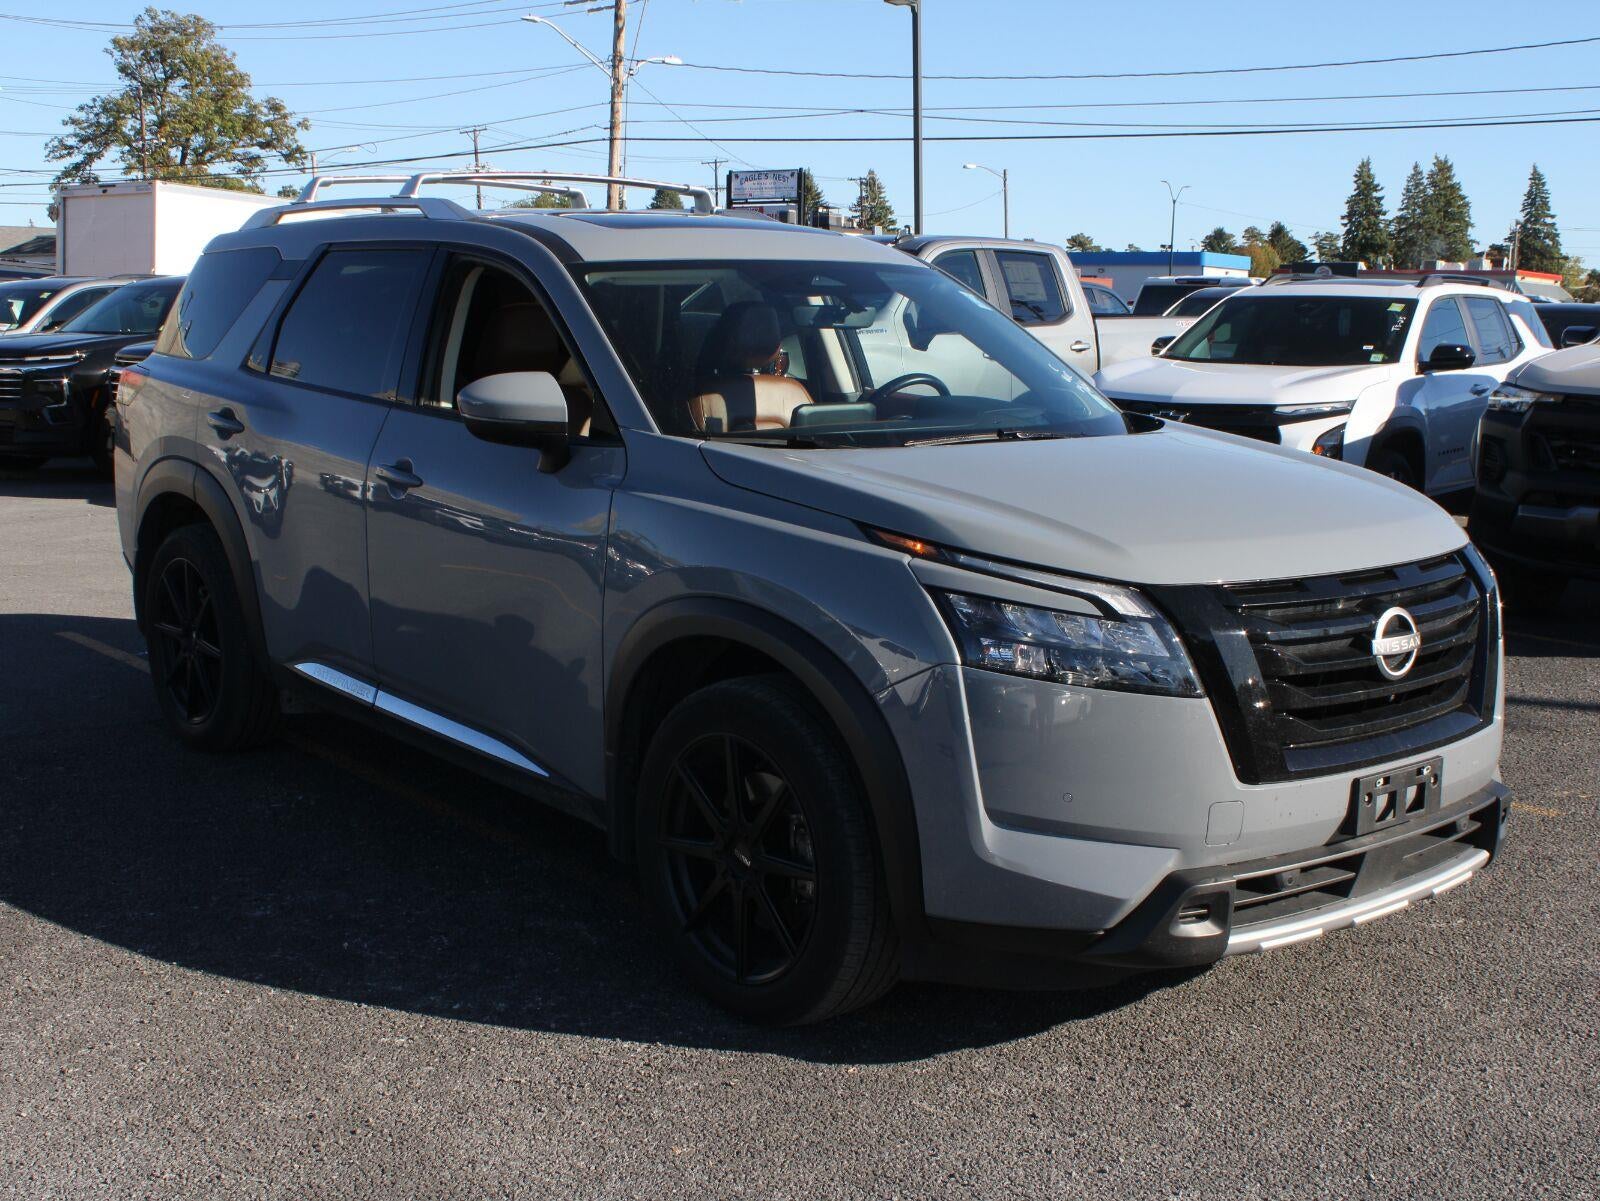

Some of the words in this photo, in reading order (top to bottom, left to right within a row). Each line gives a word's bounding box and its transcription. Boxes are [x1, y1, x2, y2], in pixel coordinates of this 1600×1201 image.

[739, 173, 768, 185] EAGLE'S
[772, 173, 789, 183] NEST
[1374, 635, 1420, 654] NISSAN
